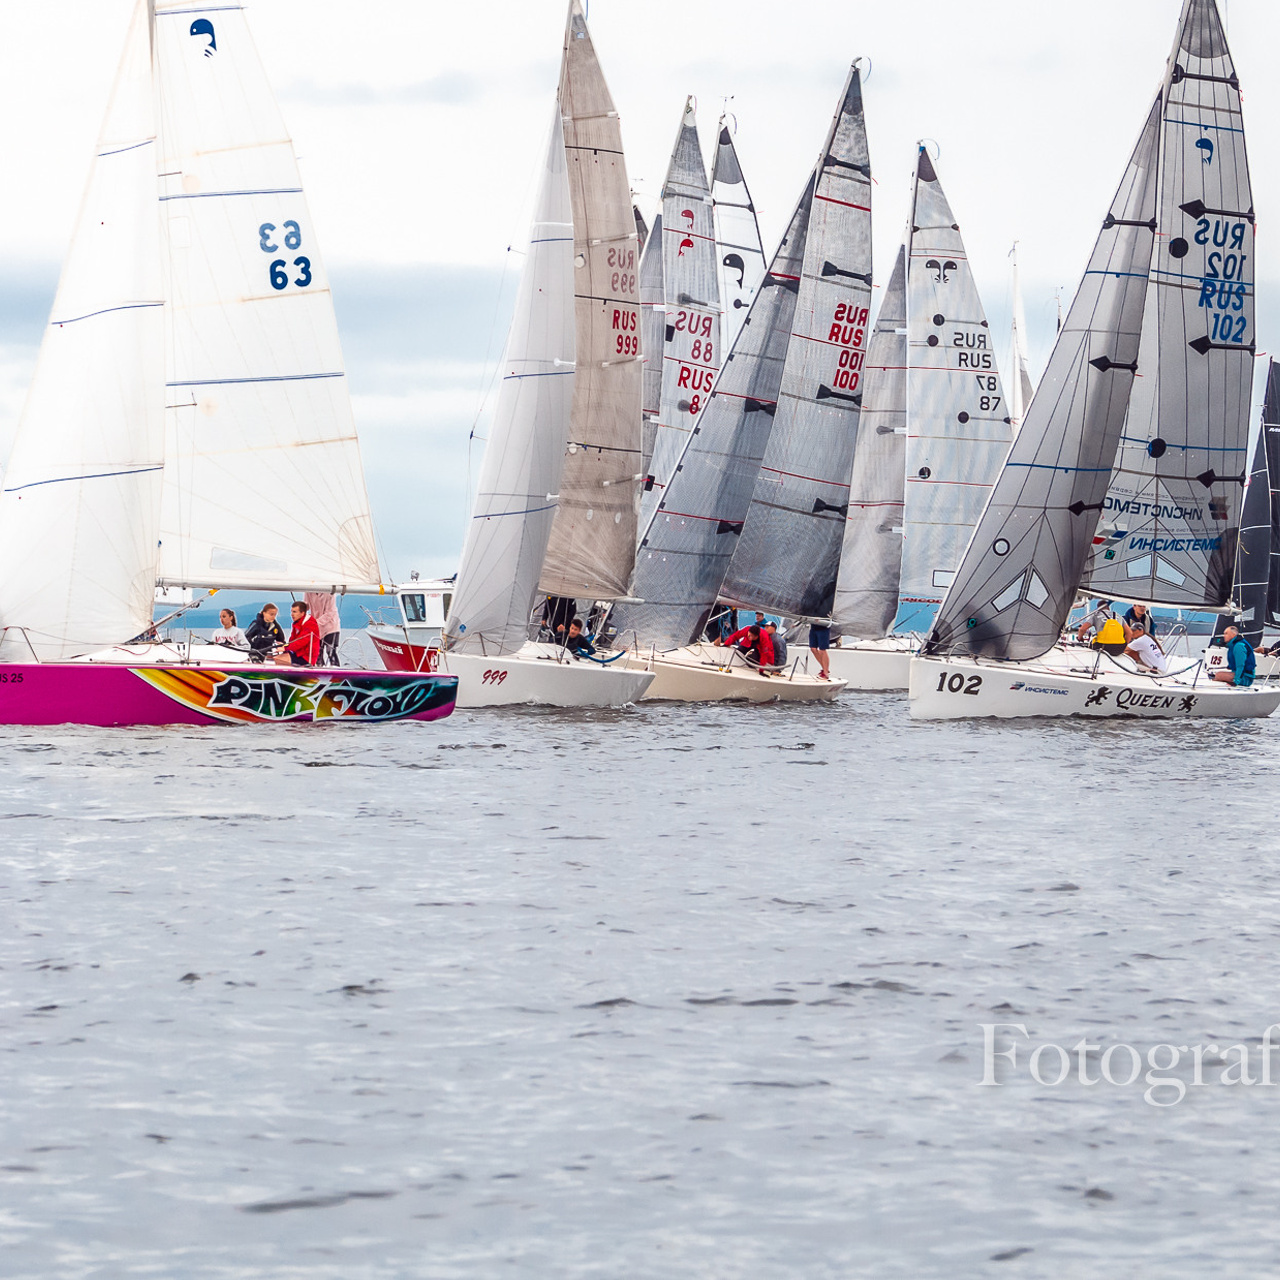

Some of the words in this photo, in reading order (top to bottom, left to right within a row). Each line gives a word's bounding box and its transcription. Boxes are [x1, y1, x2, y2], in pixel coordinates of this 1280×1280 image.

[270, 256, 312, 290] 63
[1198, 280, 1246, 311] RUS
[612, 309, 637, 331] RUS
[1212, 314, 1247, 343] 102
[616, 334, 638, 355] 999
[828, 323, 863, 347] RUS
[959, 352, 992, 369] RUS
[678, 366, 713, 393] RUS
[833, 369, 859, 391] 100
[689, 395, 707, 414] 8
[980, 396, 1001, 412] 87
[1129, 537, 1223, 552] ИНСИСТЕМС
[10, 673, 24, 683] 25
[481, 669, 508, 685] 999
[936, 671, 983, 695] 102
